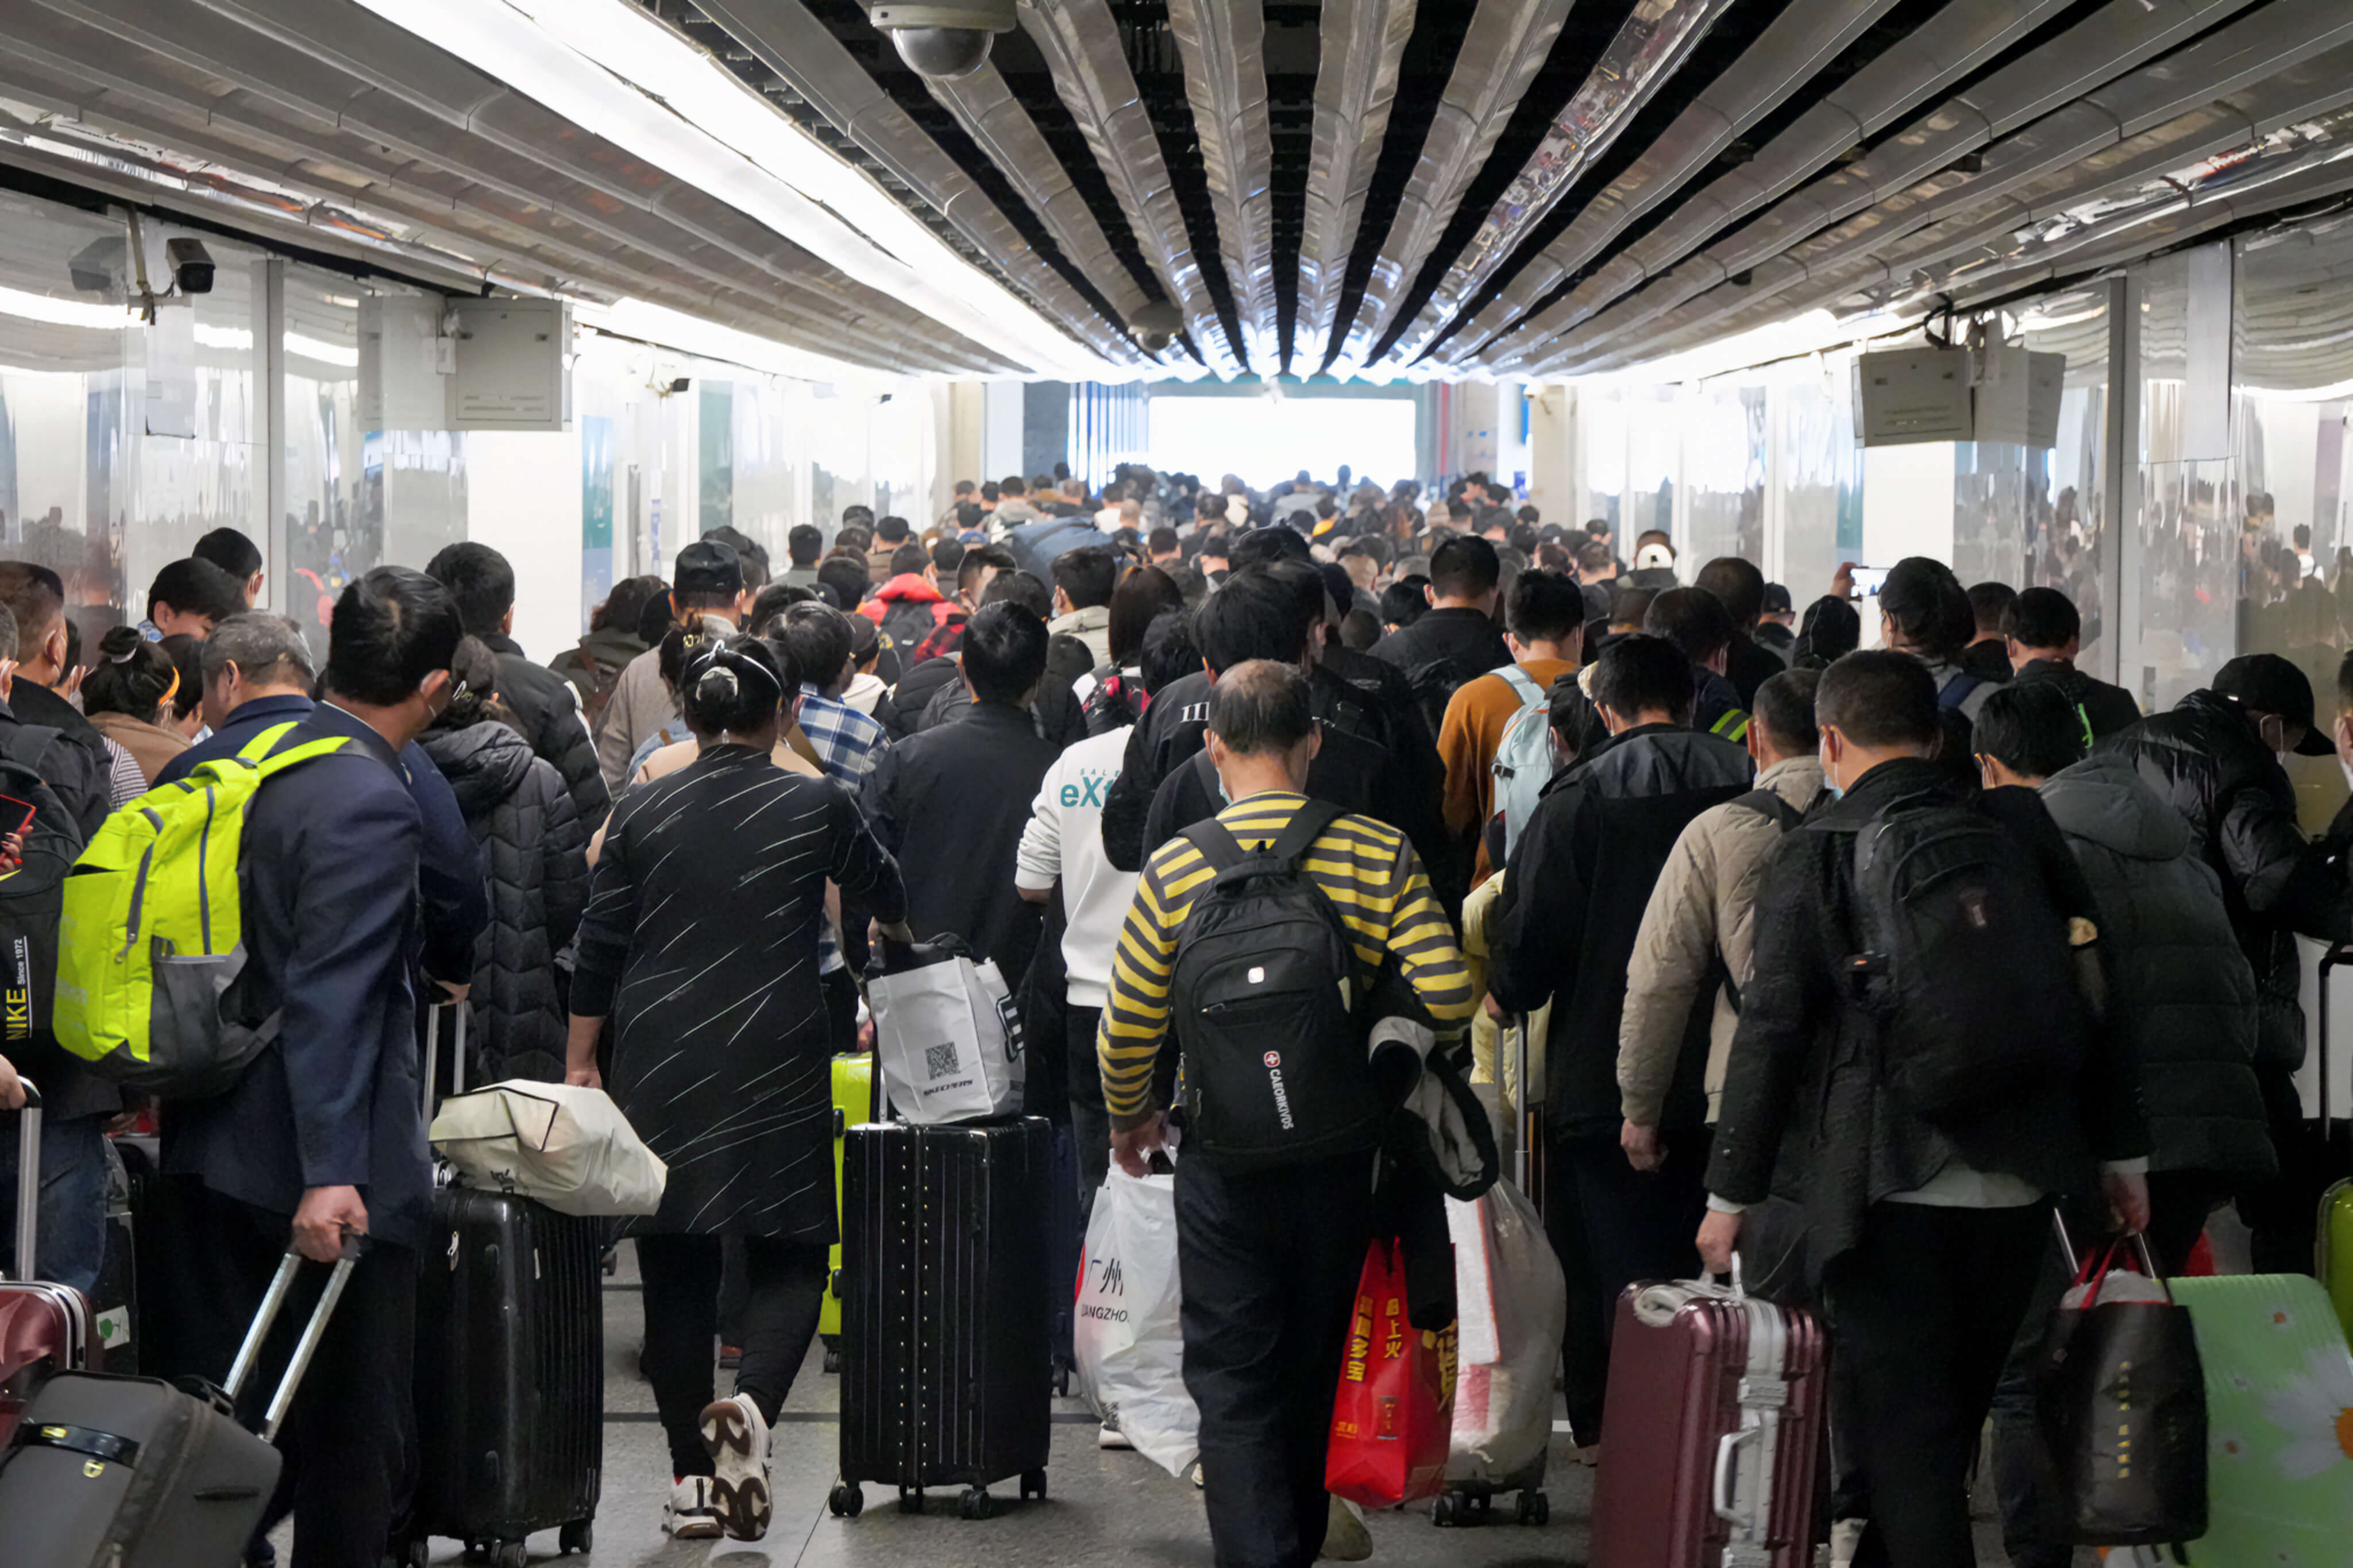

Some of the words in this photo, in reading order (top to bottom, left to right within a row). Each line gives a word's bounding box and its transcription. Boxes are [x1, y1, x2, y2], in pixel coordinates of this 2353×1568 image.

[14, 939, 24, 959] 1972
[17, 960, 26, 985] Since
[6, 988, 27, 1040] NIKE
[1085, 1258, 1124, 1296] 广州
